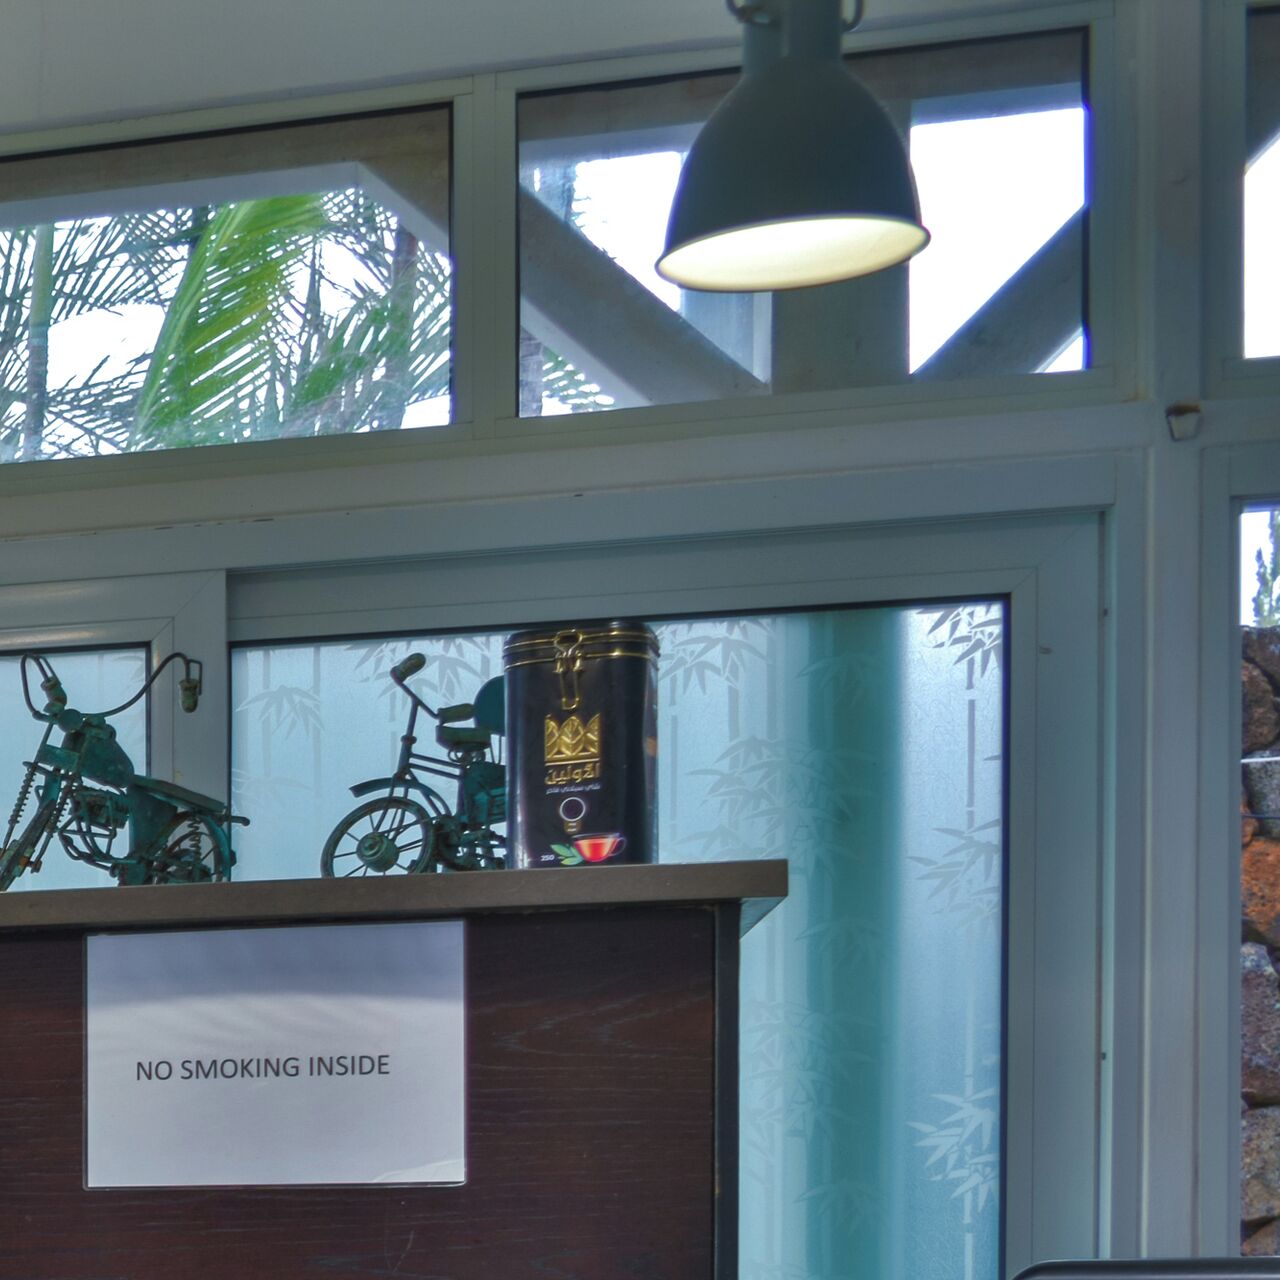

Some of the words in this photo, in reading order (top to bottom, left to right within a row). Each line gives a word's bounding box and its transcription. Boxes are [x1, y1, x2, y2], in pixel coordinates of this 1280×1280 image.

[136, 1060, 173, 1081] NO
[180, 1057, 300, 1079] SMOKING
[309, 1054, 391, 1077] INSIDE
